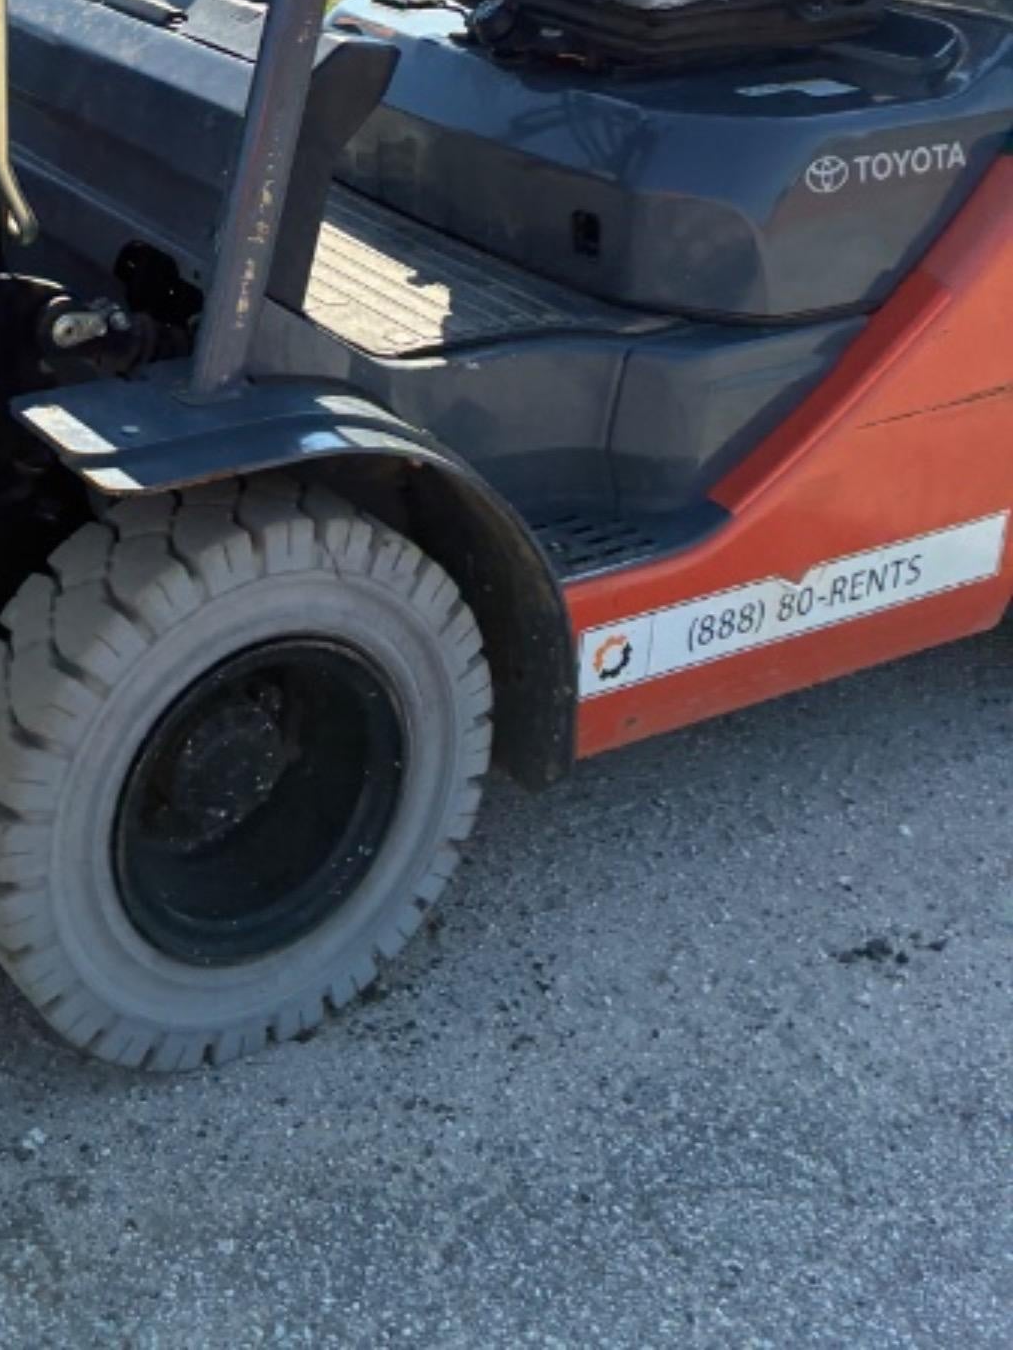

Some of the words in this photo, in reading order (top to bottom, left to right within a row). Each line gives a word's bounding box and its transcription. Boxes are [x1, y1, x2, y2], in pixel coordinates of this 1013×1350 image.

[853, 140, 967, 183] TOYOTA
[687, 600, 766, 653] (888)
[776, 554, 923, 623] 80-RENTS
